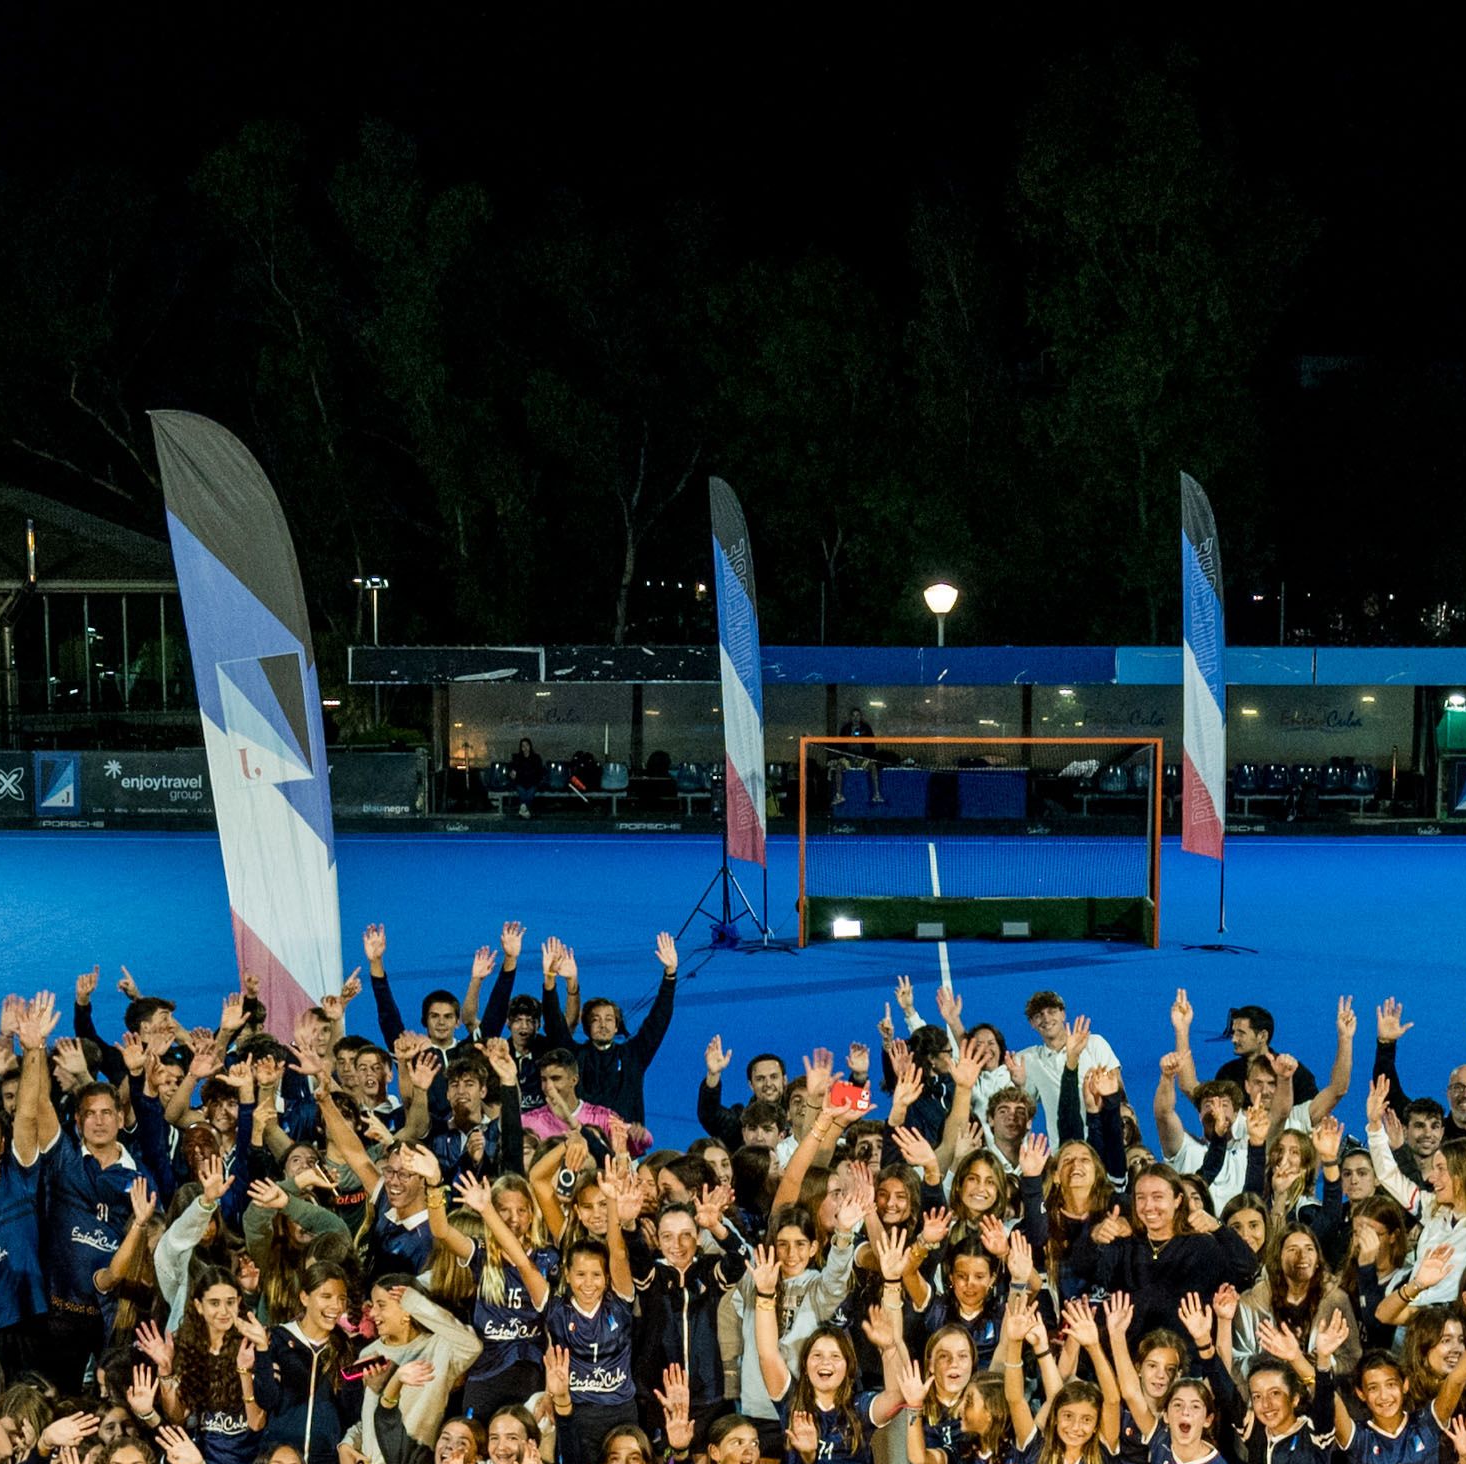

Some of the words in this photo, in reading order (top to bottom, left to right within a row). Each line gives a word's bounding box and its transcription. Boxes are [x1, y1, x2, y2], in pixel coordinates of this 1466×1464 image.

[121, 774, 203, 791] enjoytravel
[169, 789, 203, 802] group
[363, 803, 410, 814] blaunegre
[508, 1287, 522, 1309] 15
[589, 1343, 599, 1362] 7
